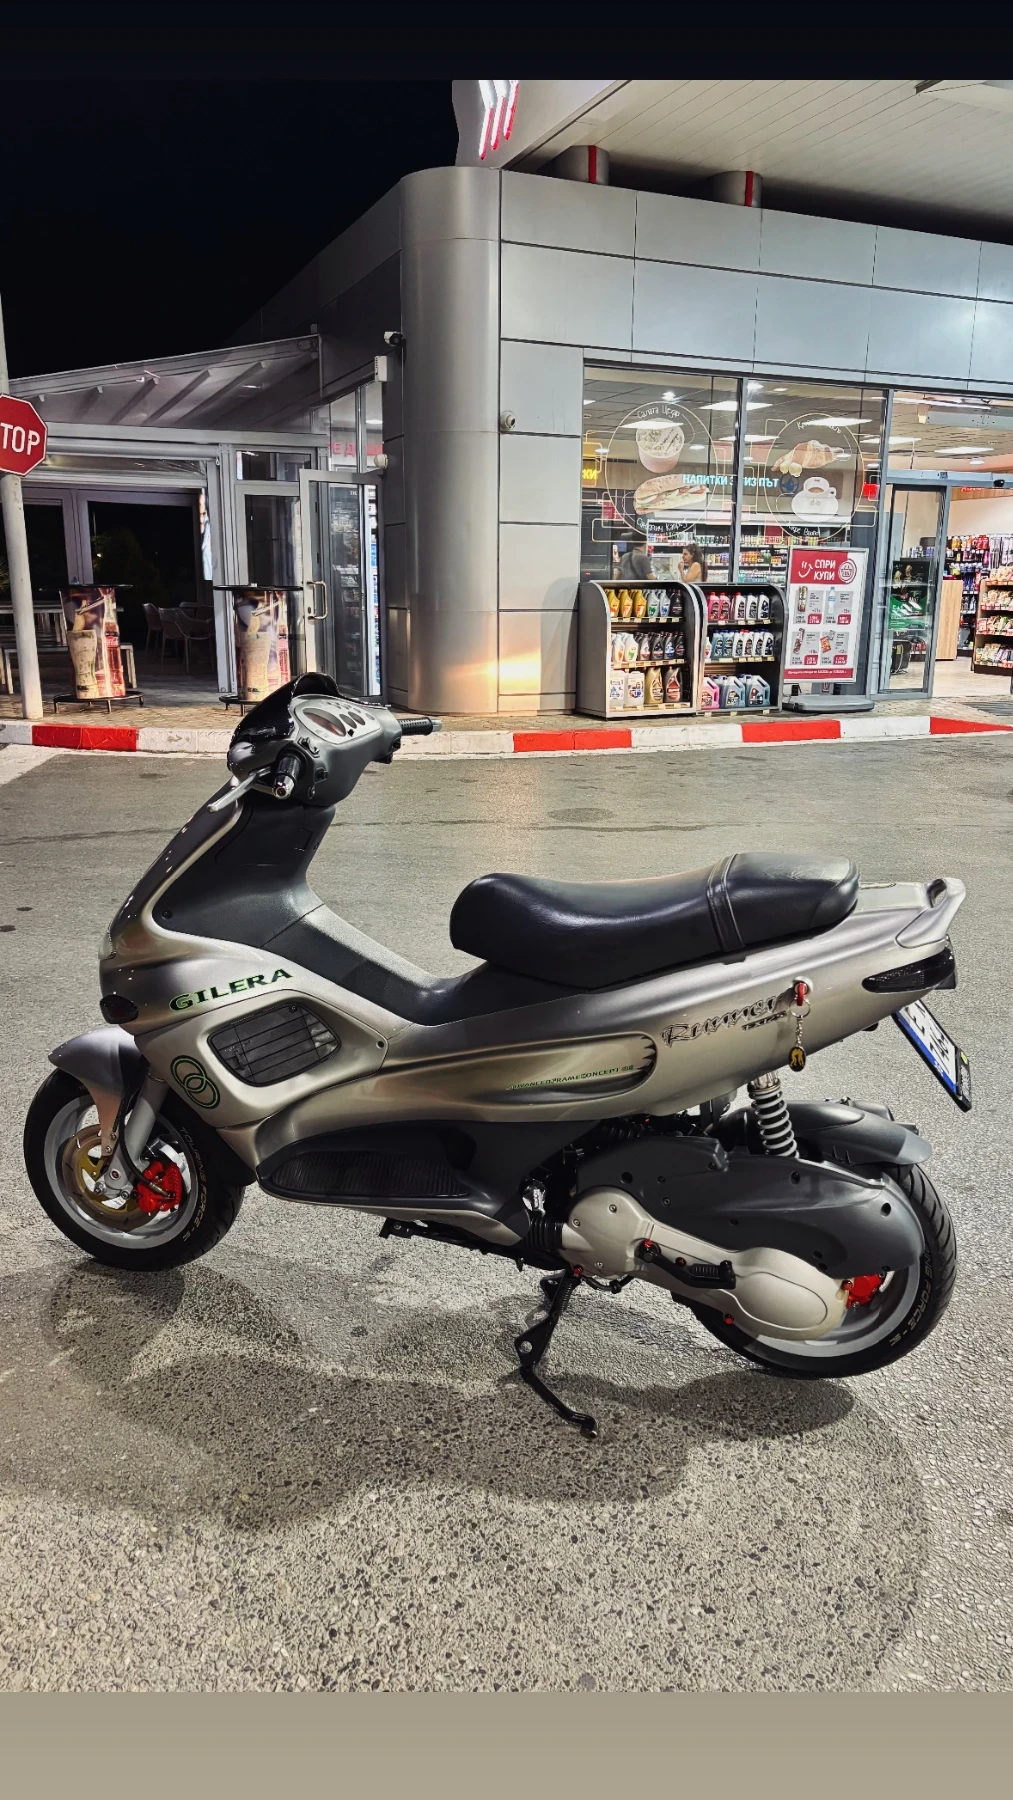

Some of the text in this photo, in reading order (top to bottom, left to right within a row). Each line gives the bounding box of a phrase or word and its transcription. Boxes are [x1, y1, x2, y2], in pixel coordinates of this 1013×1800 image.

[0, 422, 40, 455] TOP
[682, 474, 728, 486] НАПИТКИ
[744, 477, 757, 487] ИЗ
[759, 478, 779, 488] ПЪТ
[813, 571, 835, 581] КУПИ
[814, 559, 836, 569] СПРИ
[169, 968, 293, 1011] GILERA
[661, 995, 779, 1048] Runner
[194, 1182, 208, 1228] FORCE
[907, 1279, 932, 1332] FORCE
